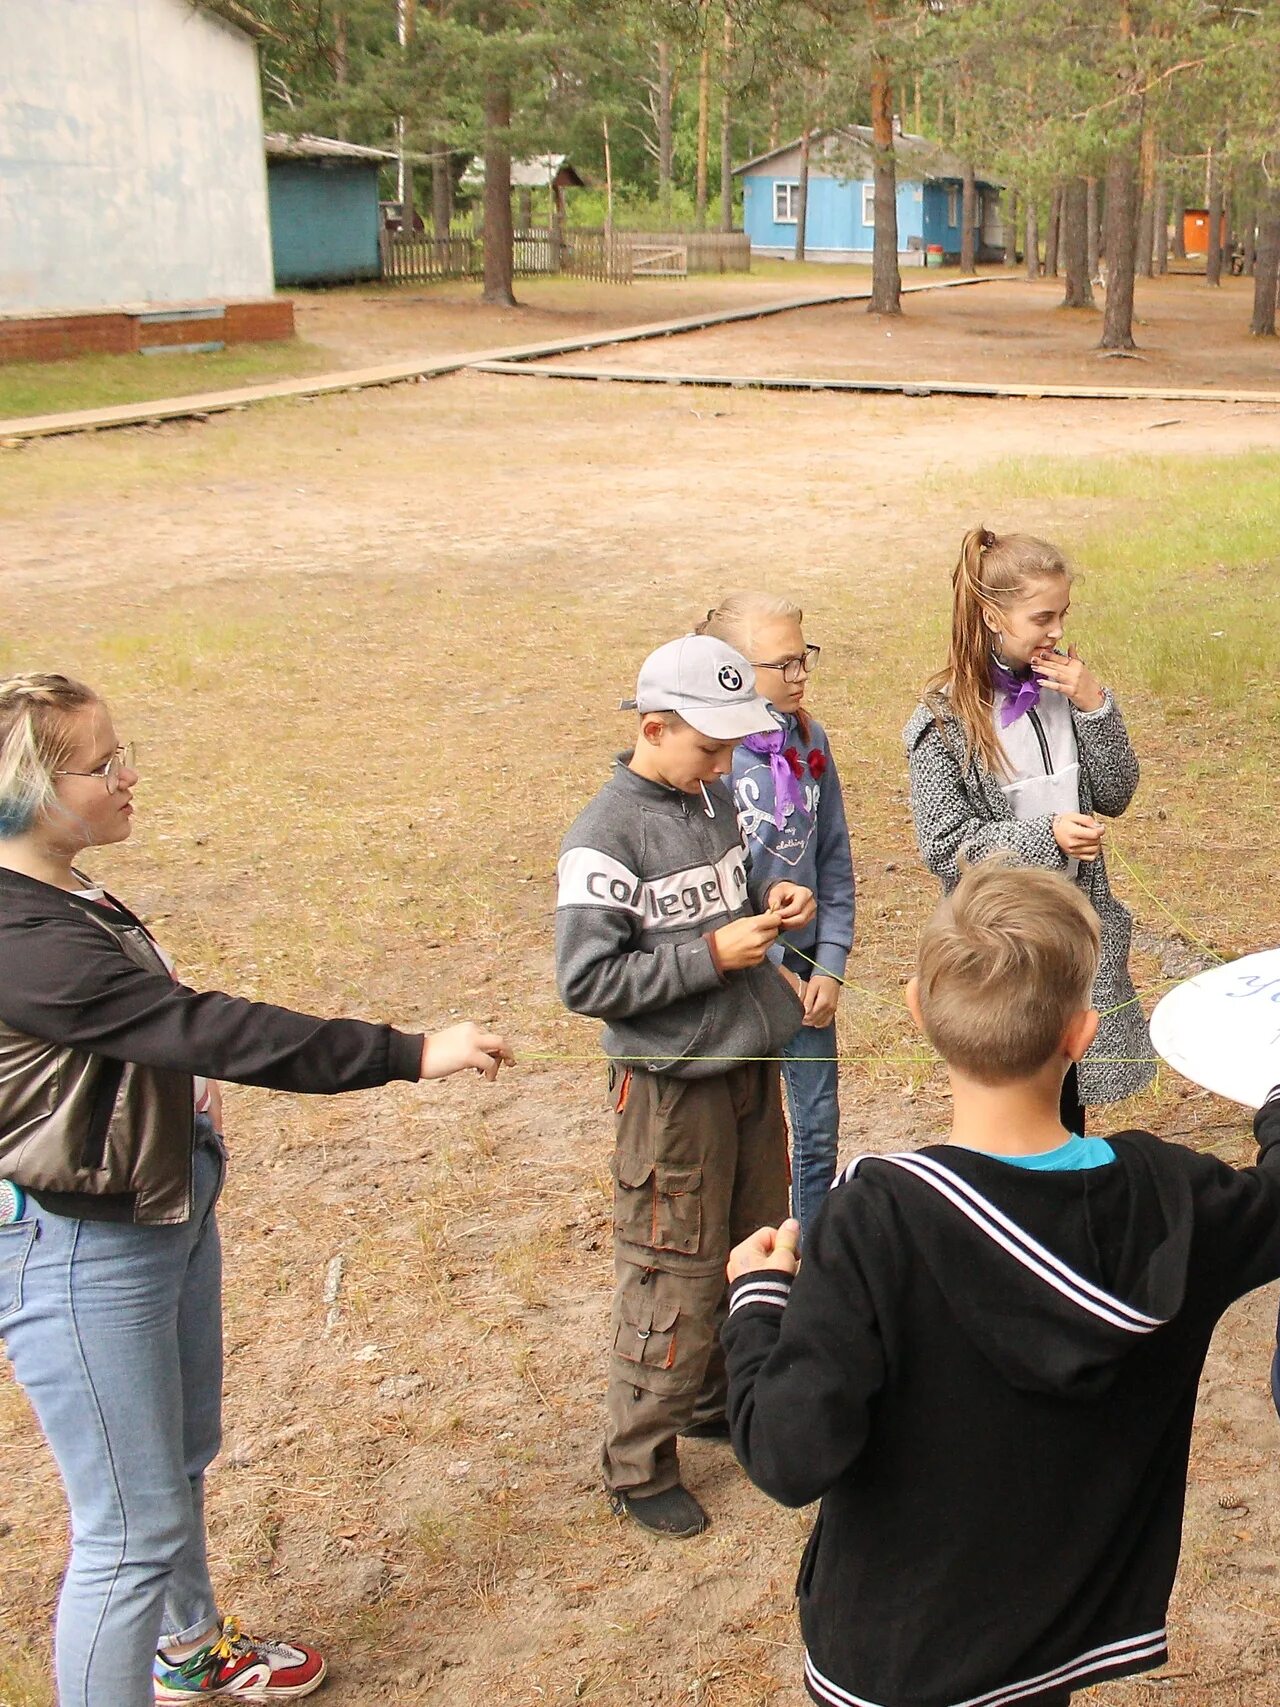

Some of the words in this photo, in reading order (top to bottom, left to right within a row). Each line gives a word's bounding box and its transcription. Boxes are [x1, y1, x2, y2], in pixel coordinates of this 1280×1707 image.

[784, 827, 797, 836] my
[775, 838, 805, 851] clothing
[586, 871, 720, 918] college
